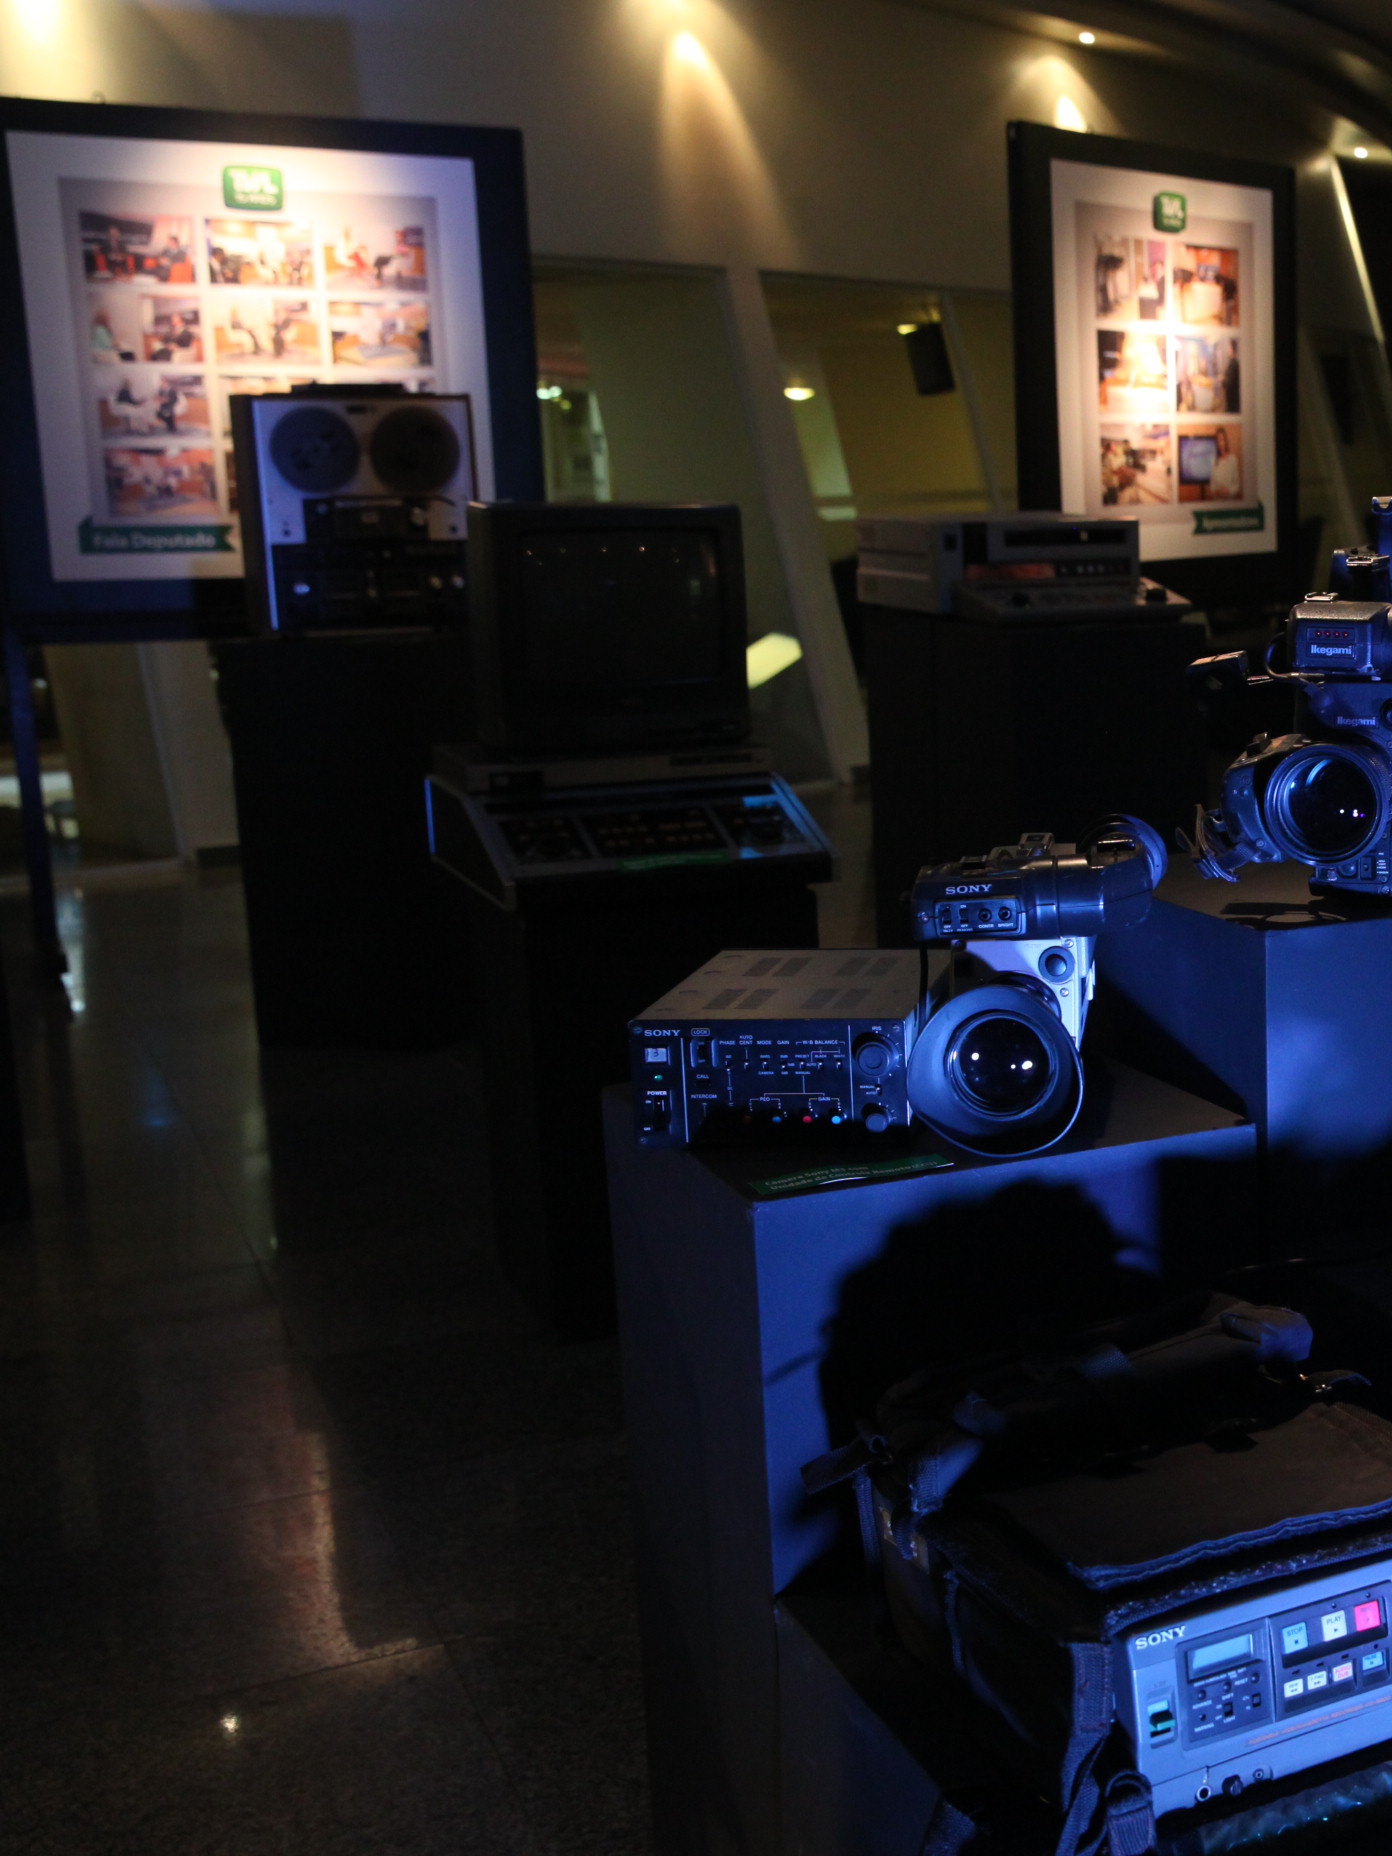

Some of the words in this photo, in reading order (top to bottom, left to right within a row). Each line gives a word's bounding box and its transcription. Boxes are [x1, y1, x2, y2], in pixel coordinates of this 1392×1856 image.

[129, 531, 217, 549] Deputado
[1310, 644, 1353, 657] Ikegami
[1337, 715, 1377, 727] Ikegami
[945, 883, 993, 895] SONY
[644, 1029, 681, 1037] SONY
[1326, 1614, 1342, 1625] PLAY
[1286, 1625, 1303, 1637] STOP
[1134, 1625, 1187, 1650] SONY
